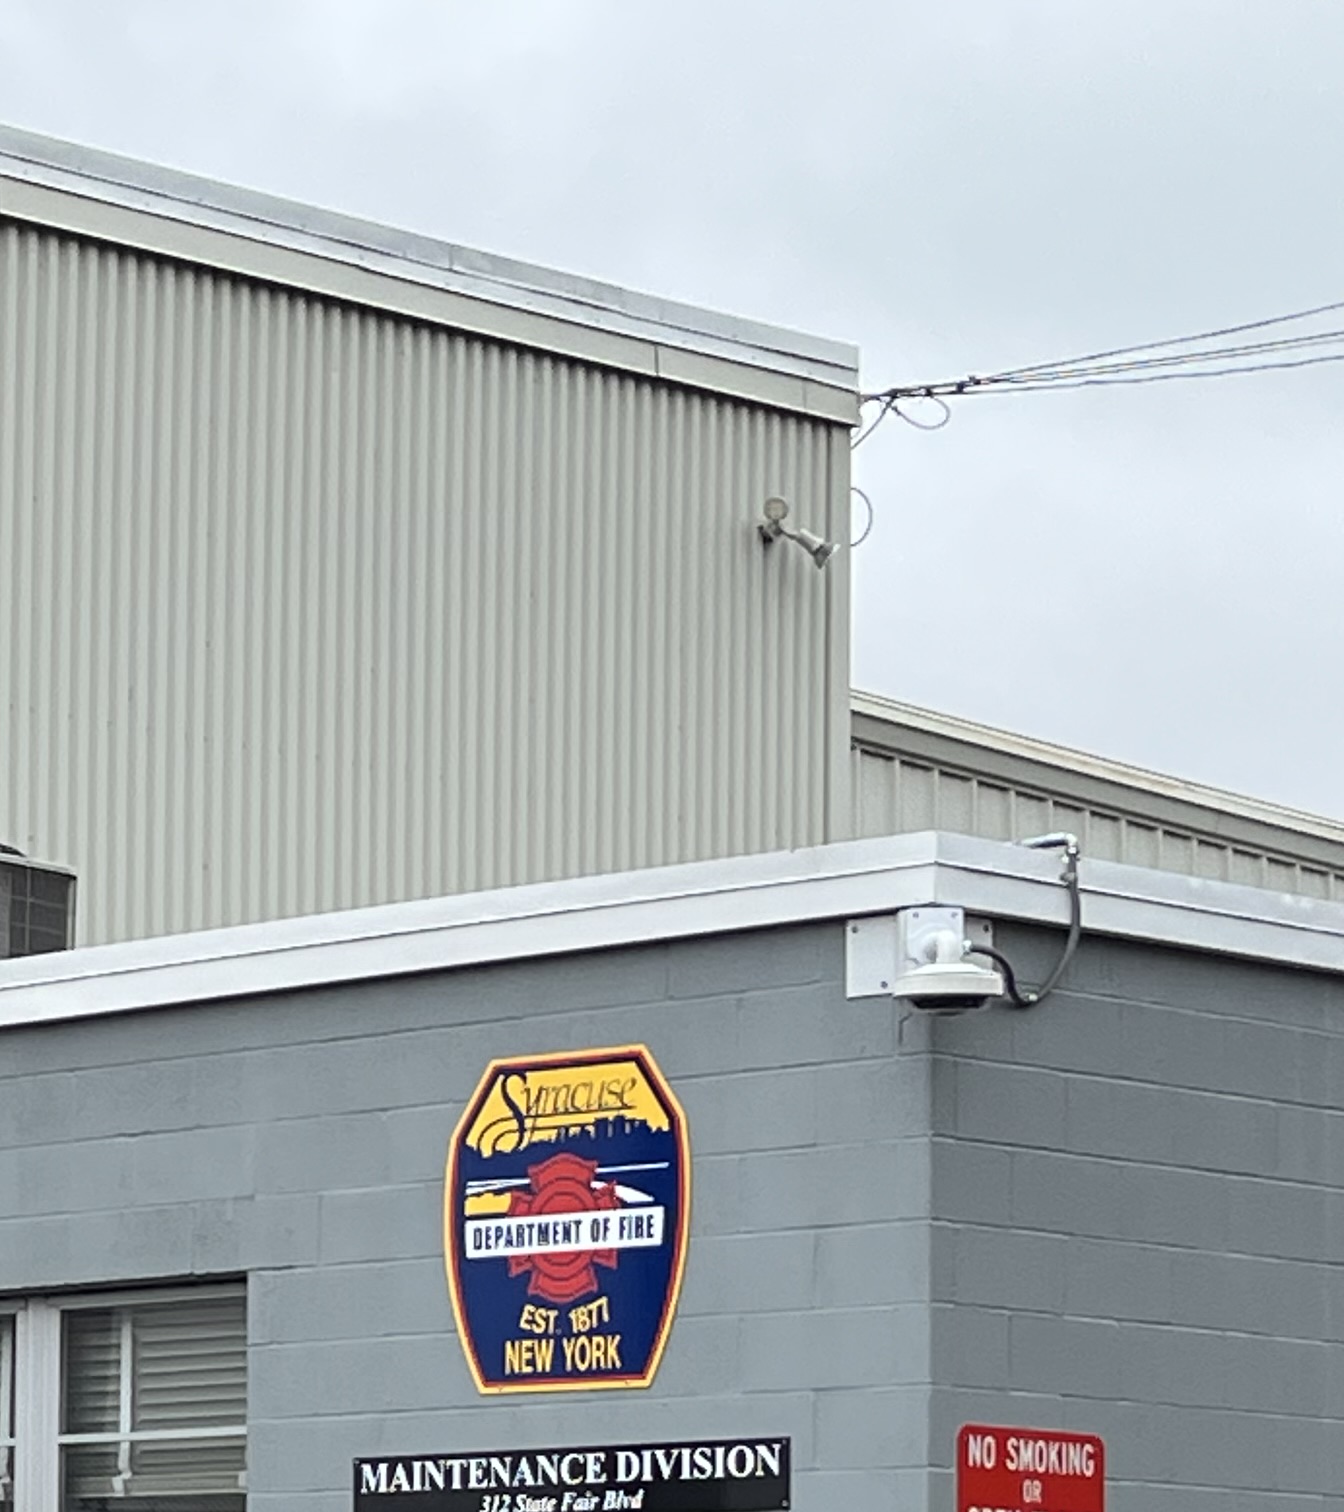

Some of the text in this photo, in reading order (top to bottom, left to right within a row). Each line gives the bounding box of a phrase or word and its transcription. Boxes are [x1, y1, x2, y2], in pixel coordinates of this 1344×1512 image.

[477, 1072, 637, 1150] Syracuse
[473, 1214, 655, 1250] DEPARTMENT OF FIRE
[569, 1296, 610, 1334] 1877
[504, 1335, 622, 1375] NEW YORK
[360, 1443, 781, 1495] MAINTENANCE DIVISION
[968, 1434, 1095, 1477] NO SMOKING
[561, 1490, 600, 1512] Fair
[602, 1488, 645, 1510] Blvd
[1022, 1478, 1042, 1503] OR
